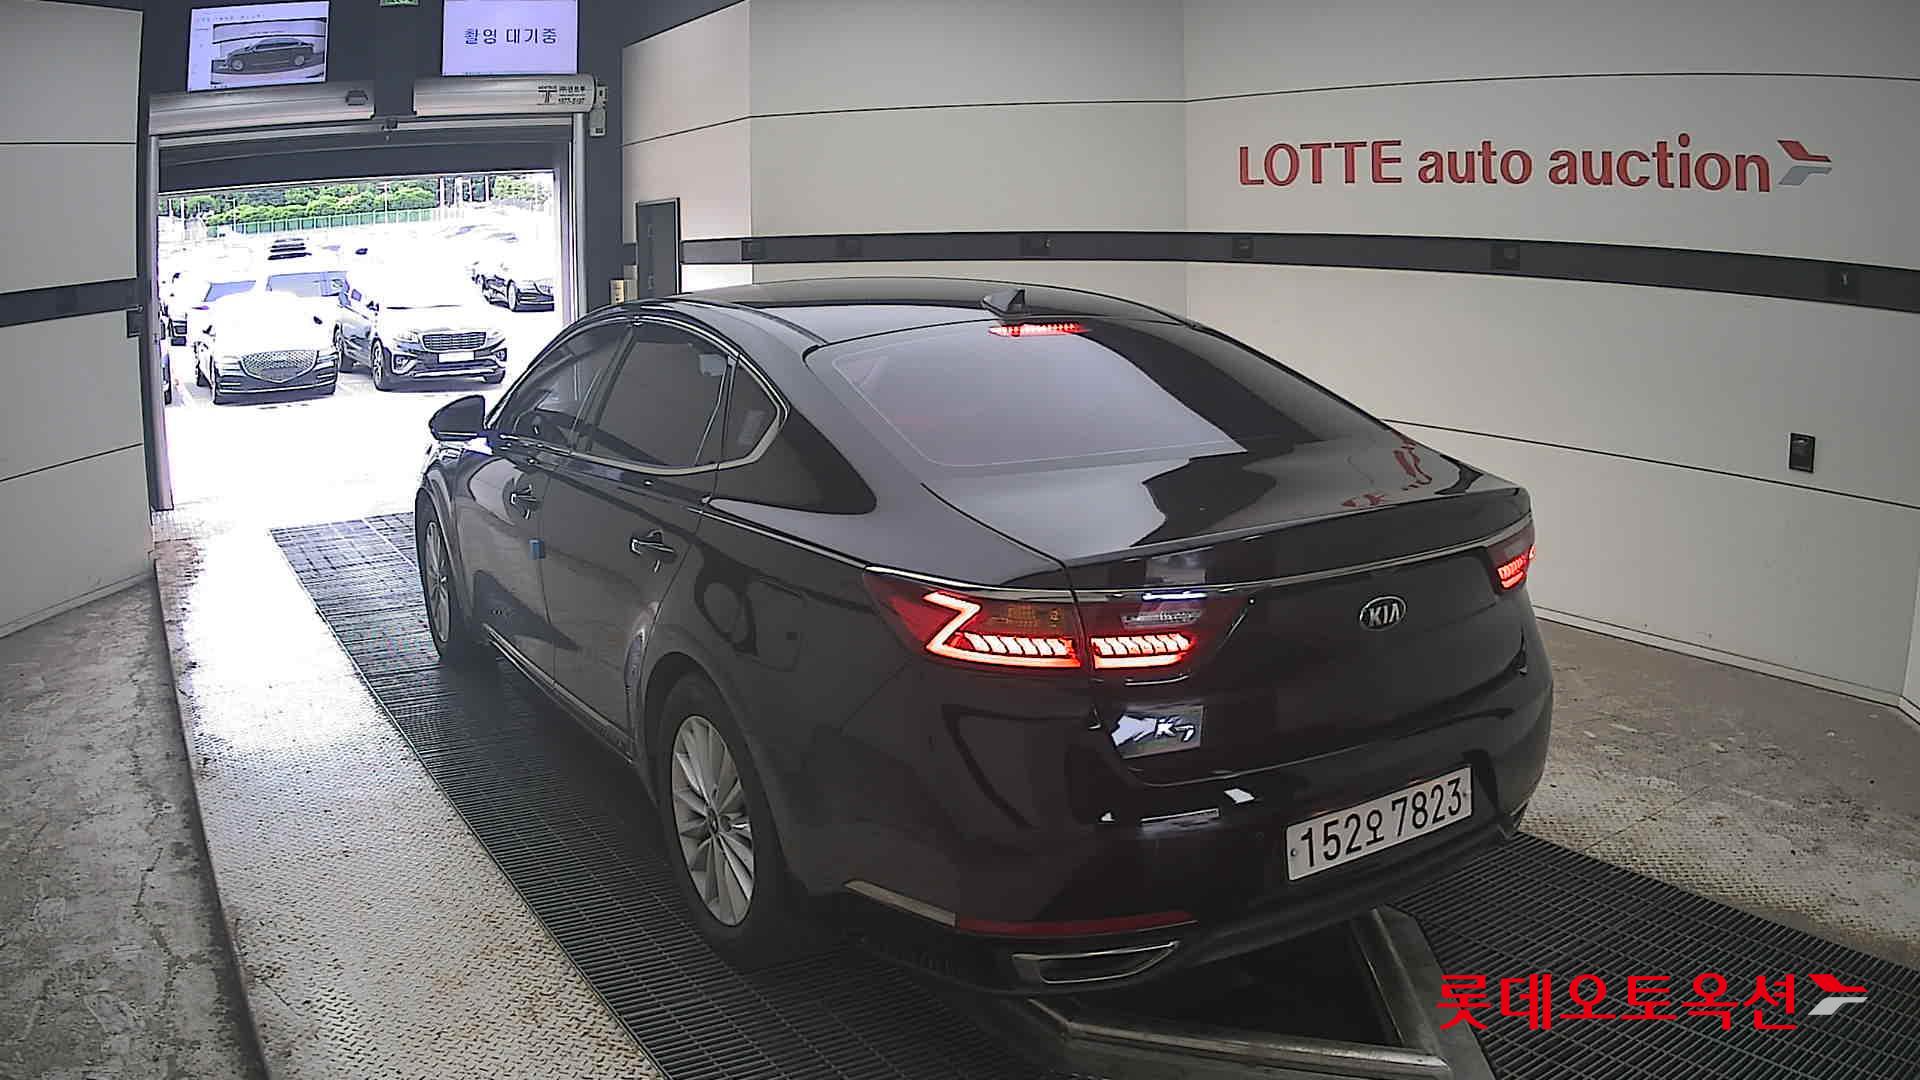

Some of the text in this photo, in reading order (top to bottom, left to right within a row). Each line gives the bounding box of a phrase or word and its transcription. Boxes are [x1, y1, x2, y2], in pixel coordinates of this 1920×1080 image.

[506, 28, 557, 45] 대기중
[1239, 133, 1771, 193] LOTTE auto auction
[1301, 777, 1462, 868] 152오 7823
